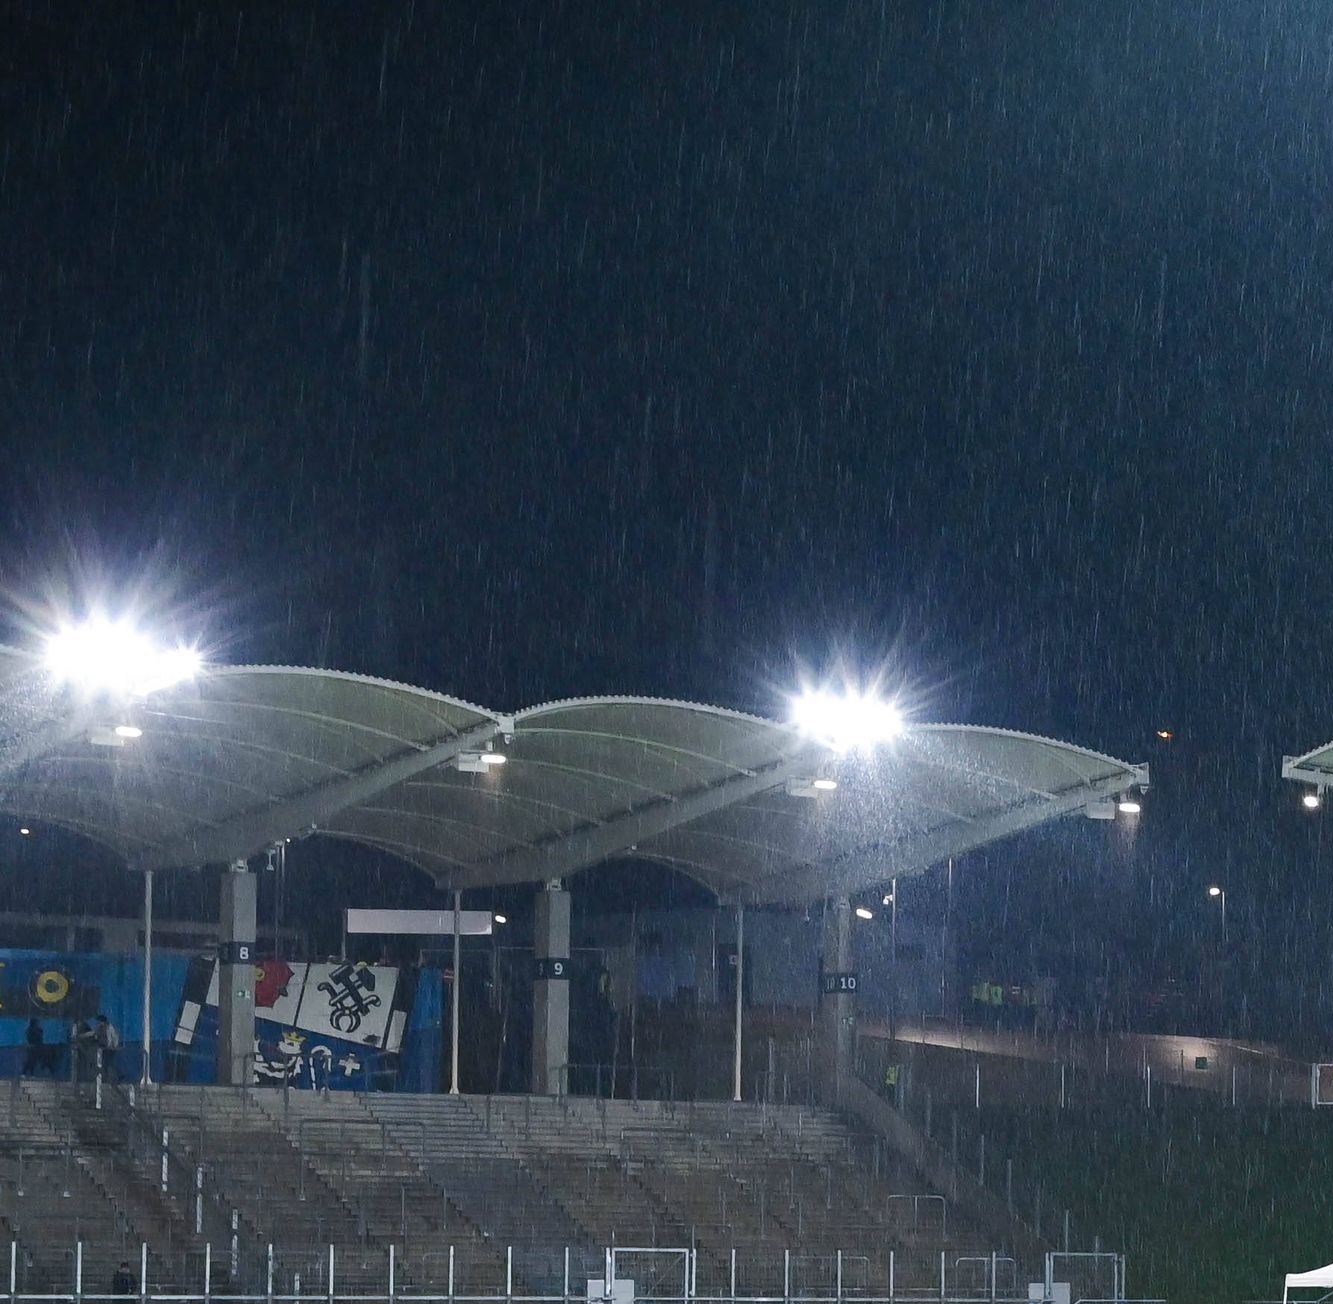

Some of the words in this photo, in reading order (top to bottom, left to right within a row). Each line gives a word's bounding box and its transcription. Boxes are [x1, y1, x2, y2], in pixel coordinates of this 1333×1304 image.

[239, 946, 250, 961] 8
[554, 962, 563, 975] 9
[840, 976, 857, 990] 10
